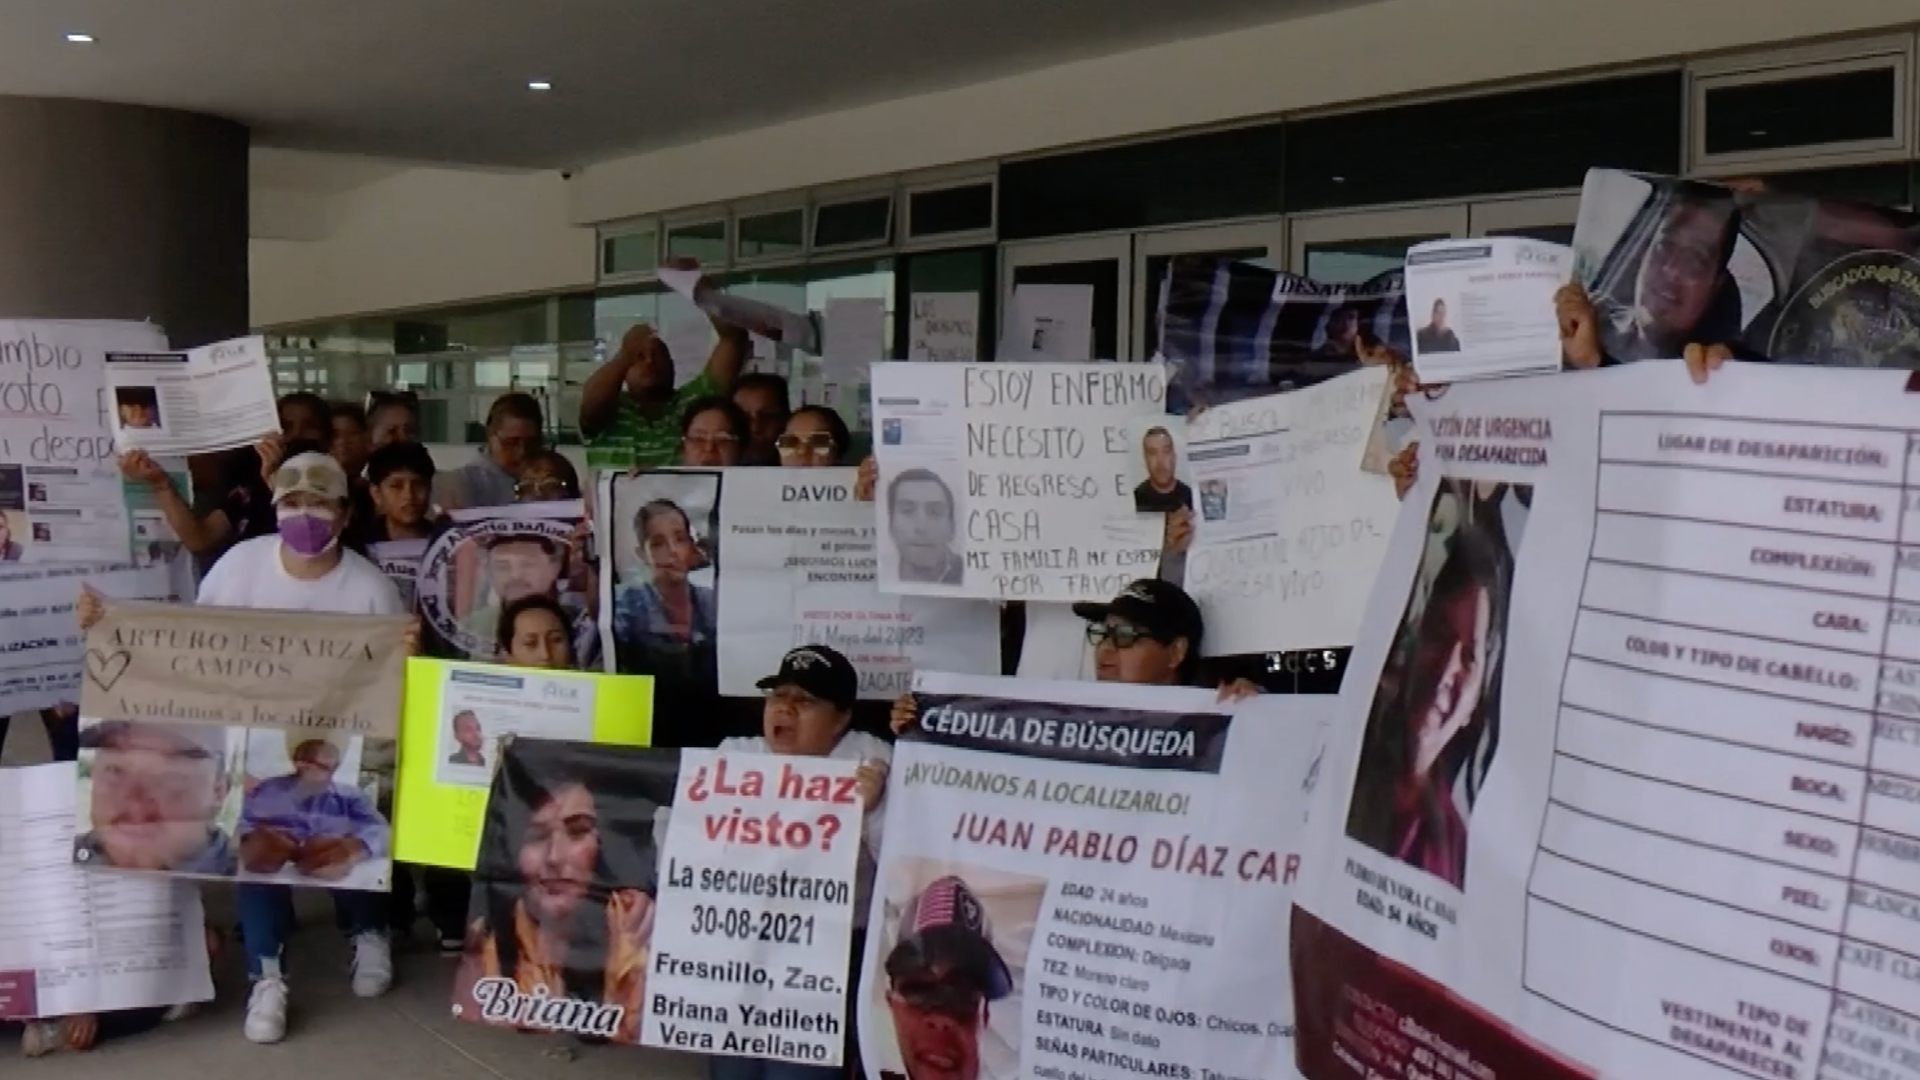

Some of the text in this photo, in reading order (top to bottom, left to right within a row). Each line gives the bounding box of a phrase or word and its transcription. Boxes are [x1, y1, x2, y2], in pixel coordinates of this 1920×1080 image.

[0, 372, 62, 416] oto
[963, 367, 1164, 410] ESTOY ENFERMO
[967, 422, 1130, 458] NECESITO ES
[1464, 417, 1482, 438] DE
[1485, 417, 1553, 440] URGENCIA
[1709, 435, 1731, 453] DE
[1458, 444, 1548, 467] DESAPARECIDA
[781, 484, 848, 502] DAVID
[968, 470, 988, 497] DE
[999, 471, 1098, 499] REGRESO
[731, 525, 764, 535] Pasan
[968, 508, 1040, 543] CASA
[966, 550, 990, 569] MI
[1003, 547, 1079, 571] FAMILIA
[993, 573, 1044, 596] POR
[1812, 610, 1869, 633] CARA:
[107, 627, 375, 661] ARTURO ESPARZA
[1625, 634, 1669, 658] COLOR
[1673, 641, 1685, 659] Y
[1691, 647, 1733, 670] TIPO
[1736, 653, 1762, 673] DE
[171, 655, 294, 679] CAMPOS
[859, 671, 912, 692] ZACATE
[118, 698, 223, 722] Ayúdanos
[228, 709, 243, 722] a
[921, 706, 1195, 758] CÉDULA DE BÚSQUEDA
[688, 758, 858, 805] ¿La haz
[904, 765, 1190, 816] ¡AYÚDANOS A LOCALIZARLO!
[705, 807, 841, 853] visto?
[953, 812, 1035, 851] JUAN
[1044, 827, 1138, 865] PABLO
[1151, 833, 1227, 879] DÍAZ
[669, 857, 850, 906] La secuestraron
[1100, 887, 1115, 903] 24
[1118, 891, 1148, 908] años
[691, 904, 815, 946] 30-08-2021
[1160, 925, 1215, 948] Mexicana
[655, 952, 842, 994] Fresnillo, Zac.
[1074, 965, 1117, 987] Moreno
[1119, 973, 1150, 992] claro
[475, 978, 624, 1038] Briana
[652, 994, 839, 1036] Briana Yadileth
[1039, 982, 1068, 1002] TIPO
[1072, 990, 1080, 1004] Y
[1082, 992, 1130, 1015] COLOR
[1132, 1003, 1152, 1021] DE
[1155, 1007, 1201, 1028] OJOS:
[1737, 1000, 1781, 1027] TIPO
[1785, 1015, 1809, 1037] DE
[660, 1022, 827, 1062] Vera Arellano
[1035, 1035, 1078, 1059] SEÑAS
[1109, 1024, 1130, 1042] Sin
[1131, 1031, 1160, 1049] dato
[1661, 999, 1773, 1049] VESTIMENTA
[1784, 1040, 1804, 1061] AL
